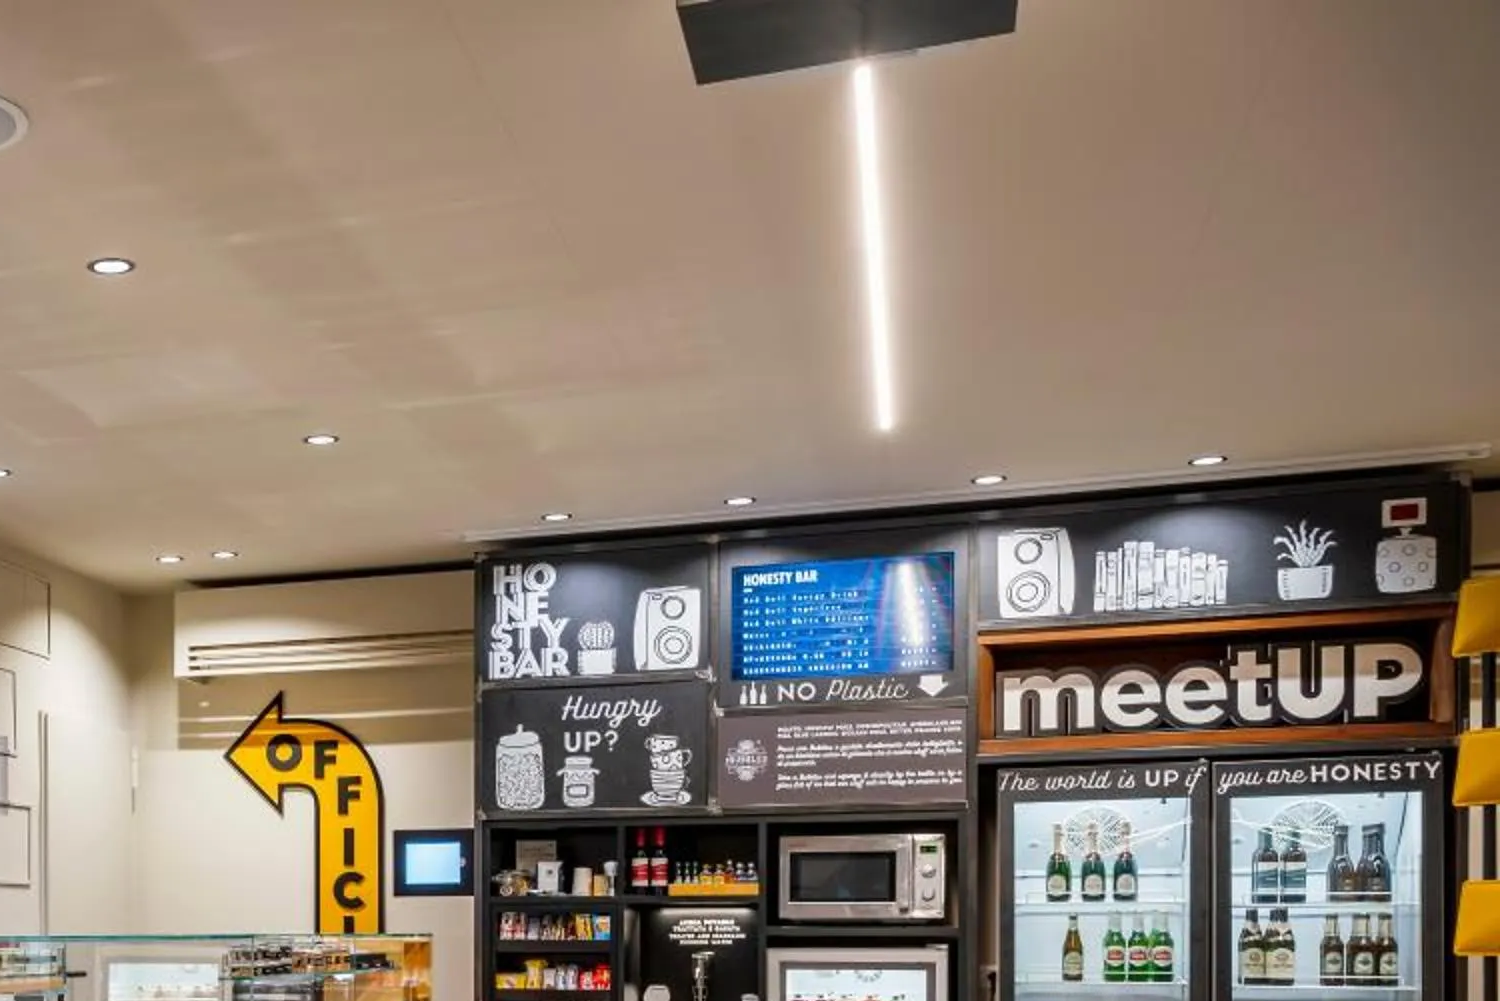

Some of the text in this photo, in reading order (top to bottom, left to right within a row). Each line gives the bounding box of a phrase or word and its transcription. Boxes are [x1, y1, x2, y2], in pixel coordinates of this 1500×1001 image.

[493, 563, 557, 595] HO
[743, 569, 819, 587] HONESTY BAR
[488, 647, 571, 680] BAR
[777, 677, 909, 702] NO Plastic
[1001, 641, 1424, 734] meetUP
[561, 695, 662, 727] Hungry
[564, 731, 619, 754] UP?
[999, 760, 1442, 795] The world is UP if you are HONESTY
